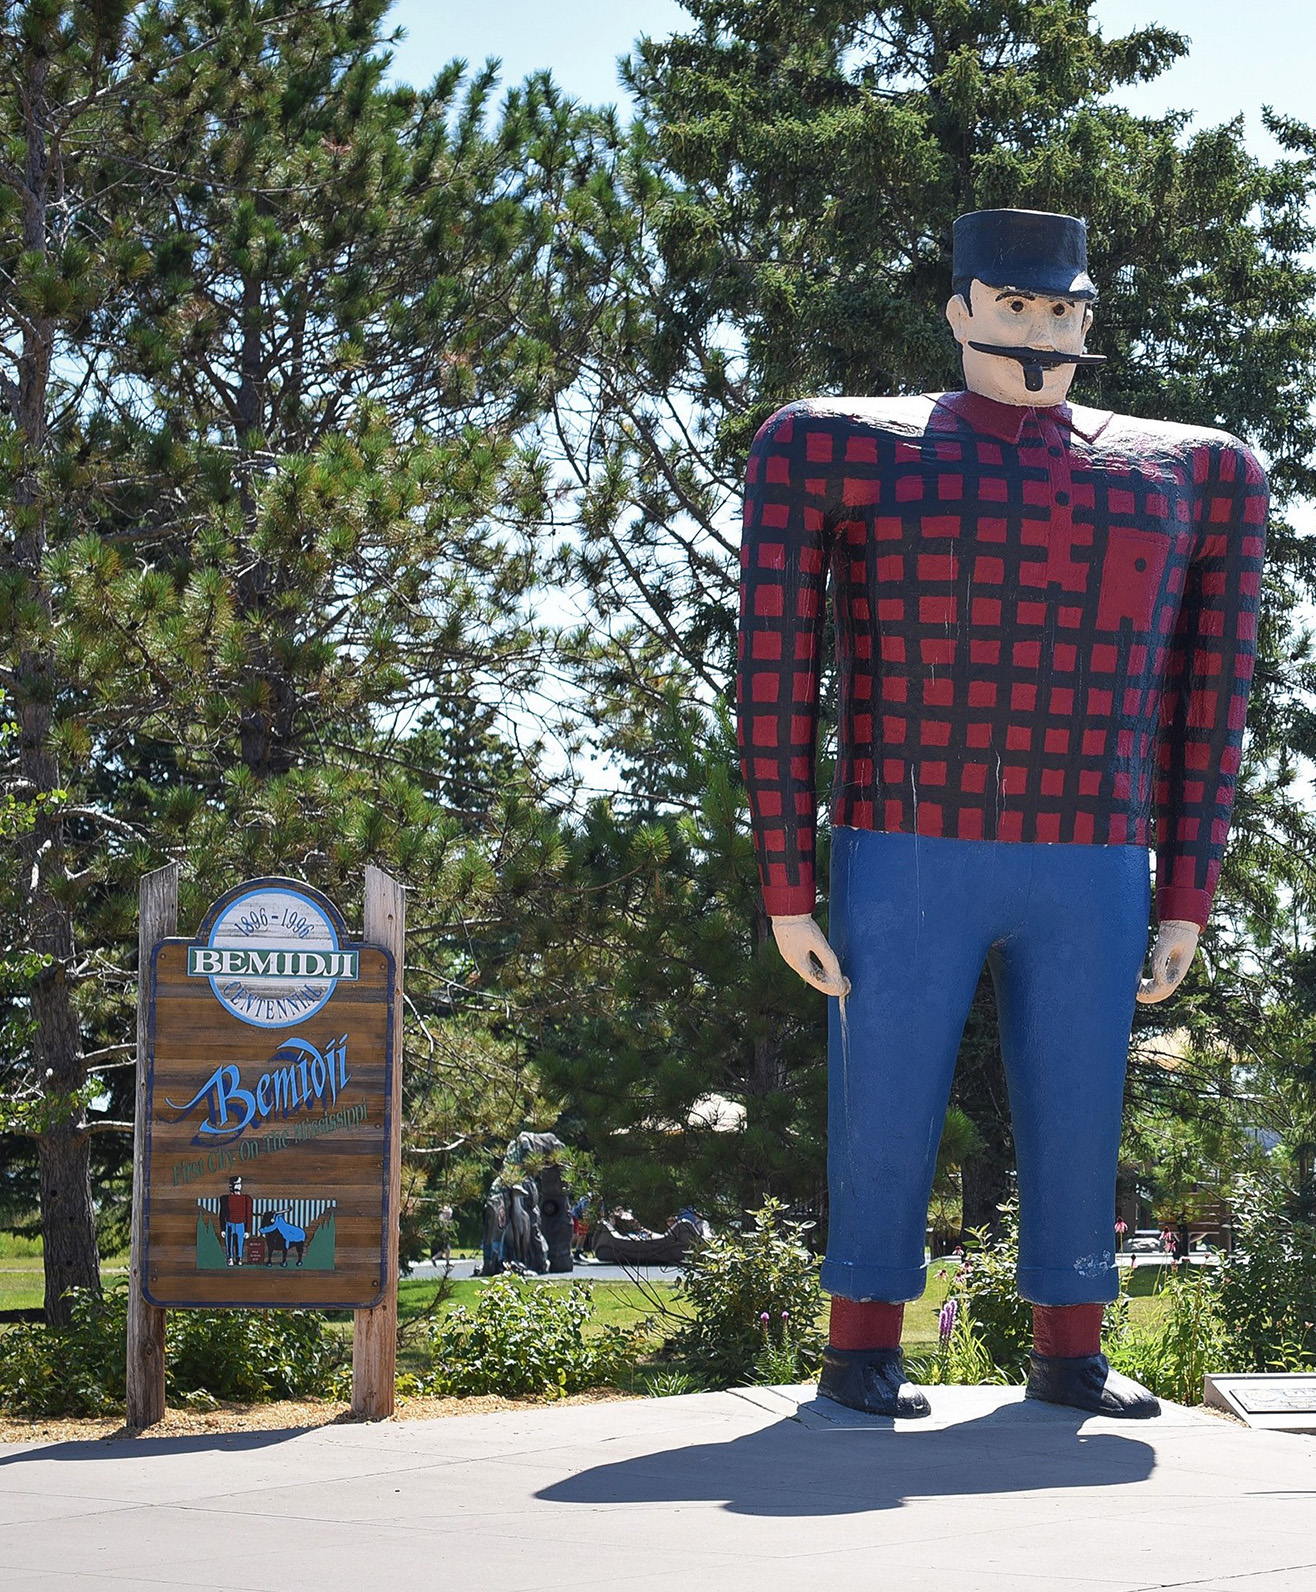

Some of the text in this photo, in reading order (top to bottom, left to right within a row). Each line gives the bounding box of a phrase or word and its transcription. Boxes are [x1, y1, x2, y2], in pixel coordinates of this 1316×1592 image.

[192, 949, 354, 978] BEMIDJI
[223, 981, 323, 1020] CENTENNIAL
[164, 1033, 352, 1135] Bemidji
[172, 1097, 369, 1187] First City On The Mississippi
